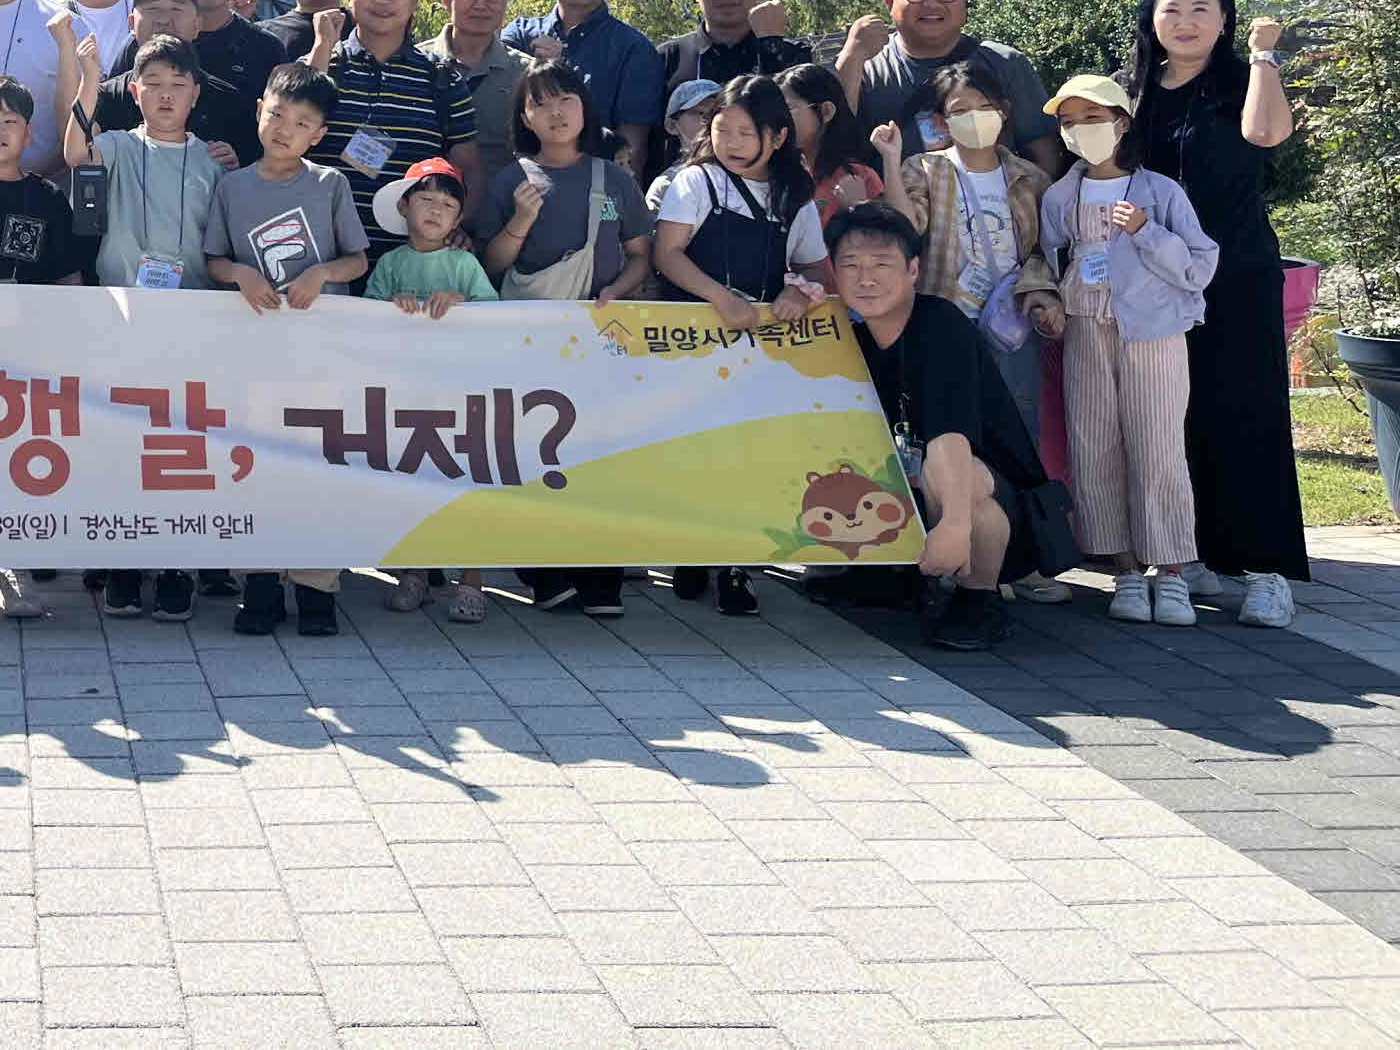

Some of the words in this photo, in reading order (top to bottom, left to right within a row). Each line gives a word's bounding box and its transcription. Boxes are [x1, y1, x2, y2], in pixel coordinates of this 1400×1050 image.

[643, 314, 841, 353] 밀양시가족센터
[109, 380, 255, 491] 갈,
[283, 386, 577, 490] 거제?
[79, 513, 160, 541] 경상남도
[163, 513, 207, 536] 거제
[212, 512, 255, 540] 일대
